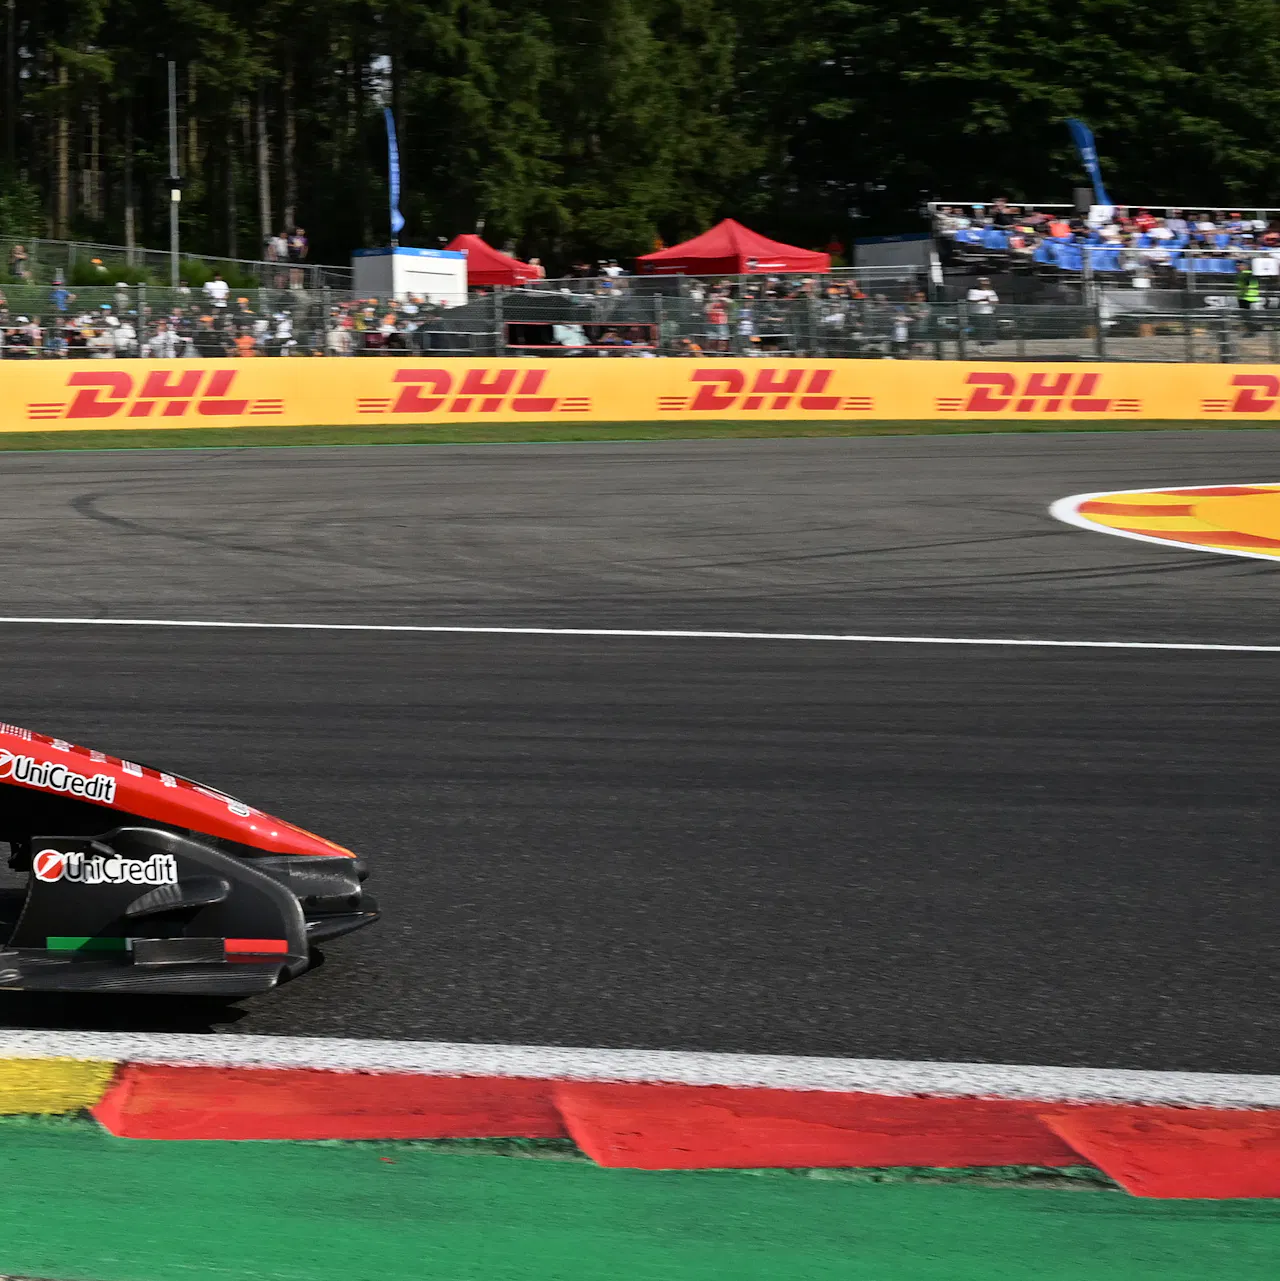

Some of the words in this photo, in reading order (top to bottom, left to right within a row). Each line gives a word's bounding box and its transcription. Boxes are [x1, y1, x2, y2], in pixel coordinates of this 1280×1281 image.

[65, 370, 249, 419] DHL
[390, 369, 558, 413] DHL
[688, 369, 842, 411] DHL
[964, 373, 1112, 412] DHL
[14, 756, 115, 802] UniCredit
[64, 852, 178, 884] UniCredit
